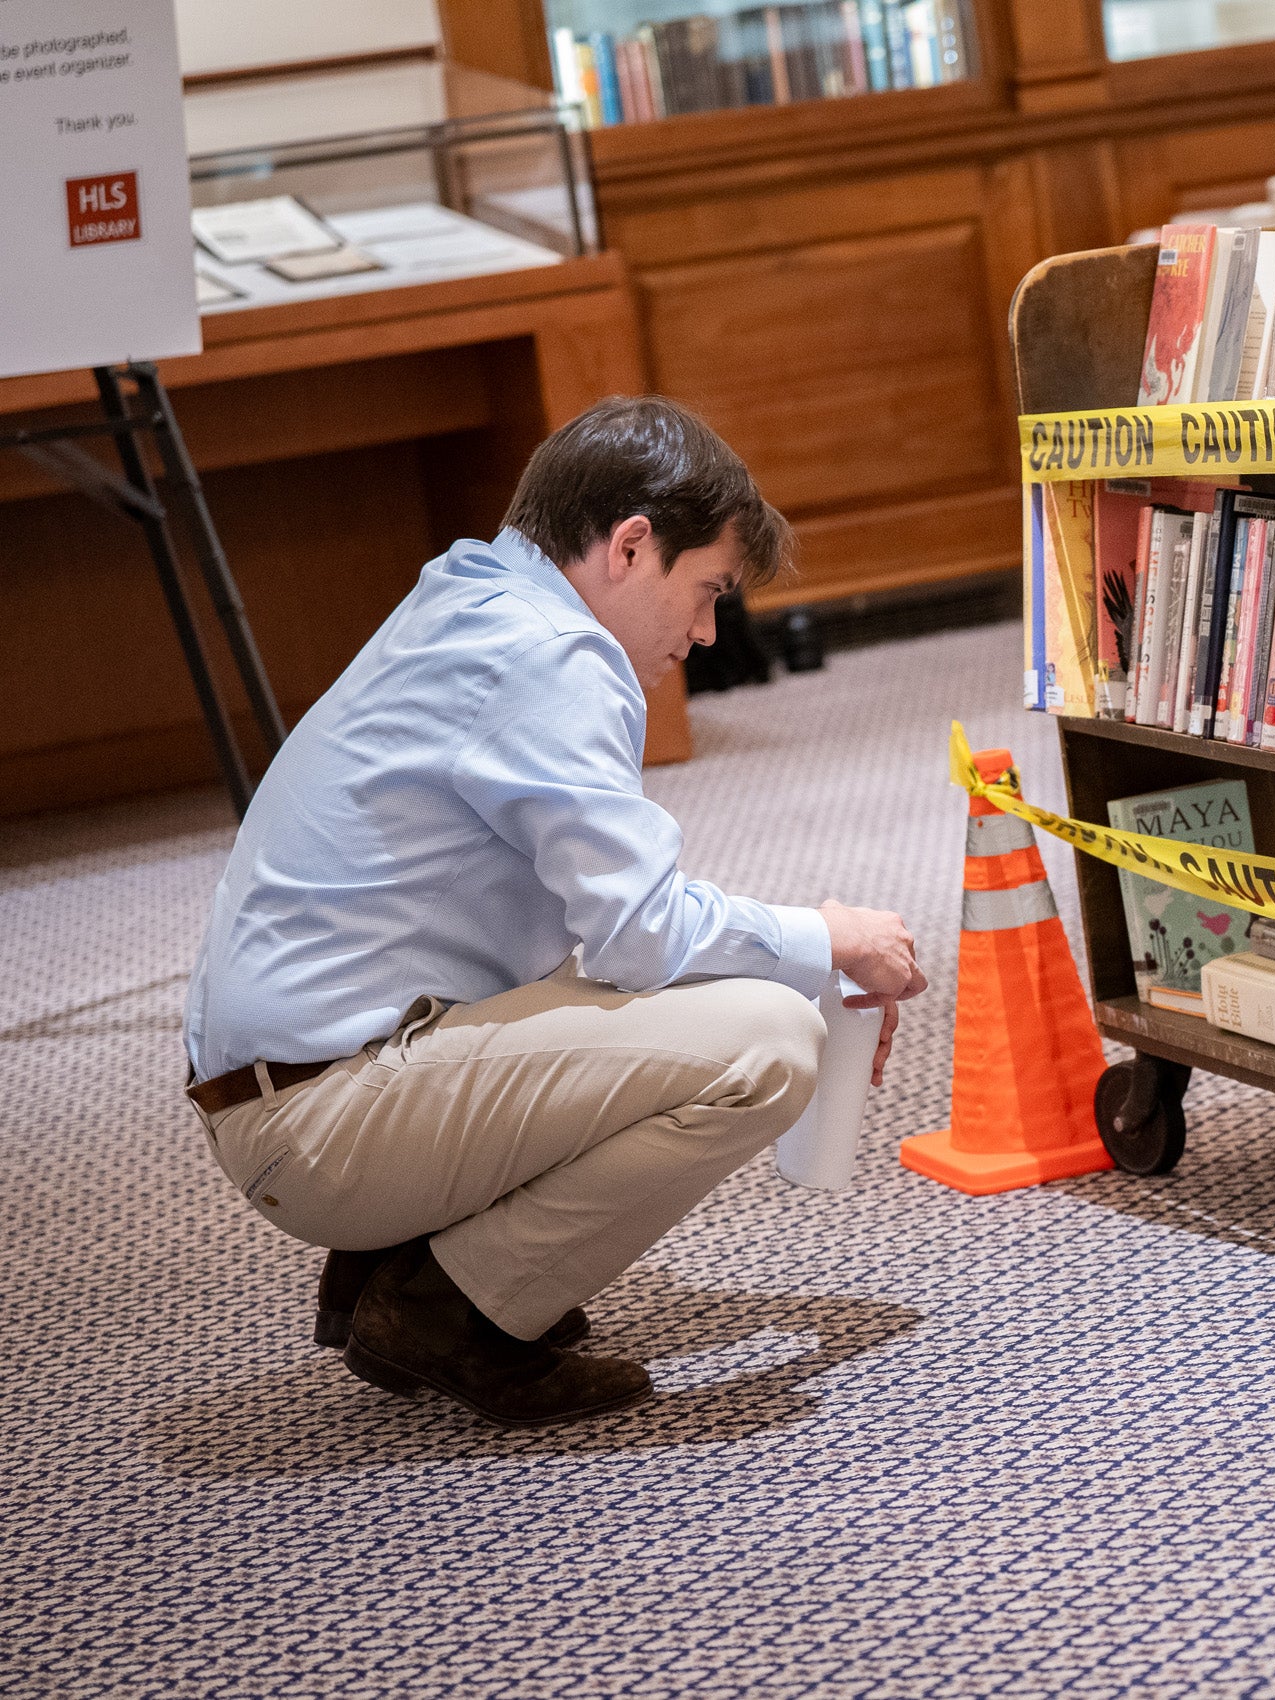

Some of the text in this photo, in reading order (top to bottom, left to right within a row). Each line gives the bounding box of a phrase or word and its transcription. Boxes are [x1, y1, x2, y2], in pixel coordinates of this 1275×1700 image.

[22, 26, 132, 58] photographed.
[14, 61, 56, 81] event
[55, 112, 139, 134] Thank you.
[79, 181, 128, 214] HLS
[73, 216, 138, 245] LIBRARY
[1029, 413, 1154, 472] CAUTION
[1136, 797, 1241, 837] MAYA
[1218, 984, 1230, 1024] Holy
[1231, 987, 1242, 1028] Bible
